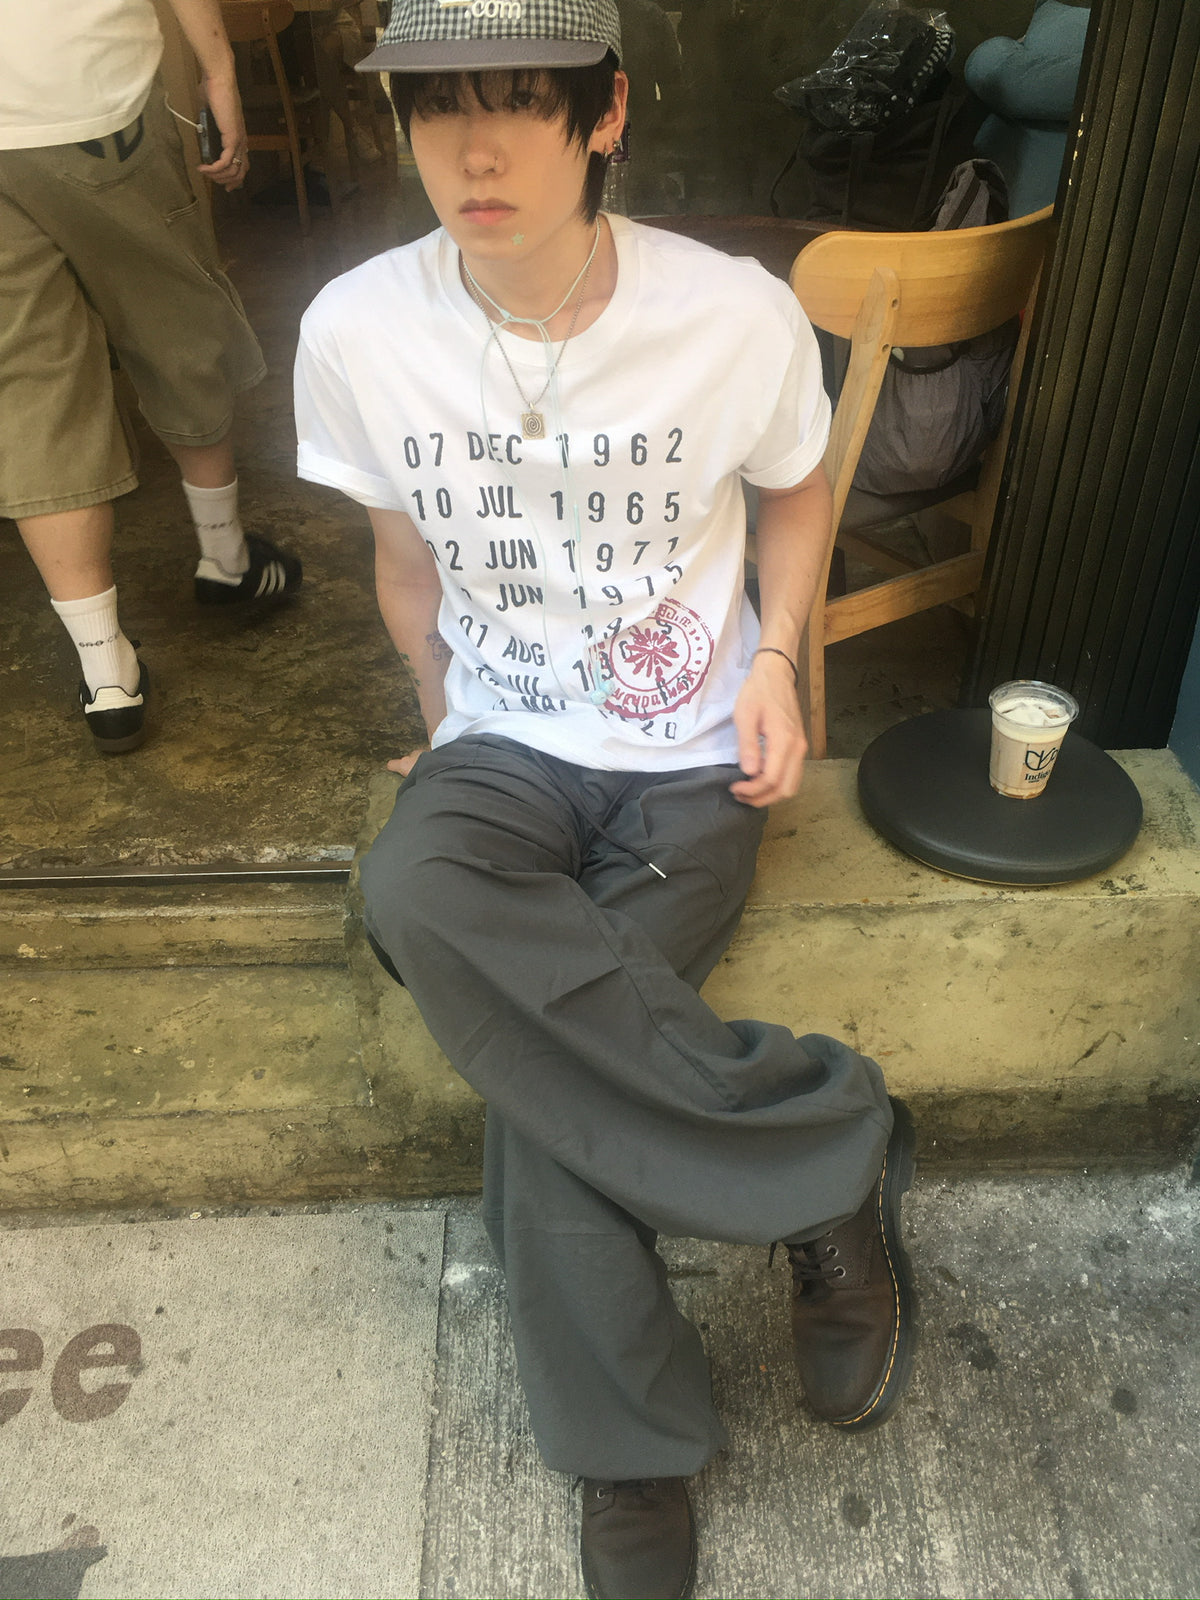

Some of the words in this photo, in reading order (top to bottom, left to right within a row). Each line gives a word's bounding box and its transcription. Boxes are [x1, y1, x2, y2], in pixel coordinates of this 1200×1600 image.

[464, 0, 521, 19] .com
[466, 431, 522, 465] DEC
[476, 485, 523, 519] JUL
[485, 538, 537, 570] JUN
[496, 583, 544, 612] JUN
[502, 635, 545, 667] AUG
